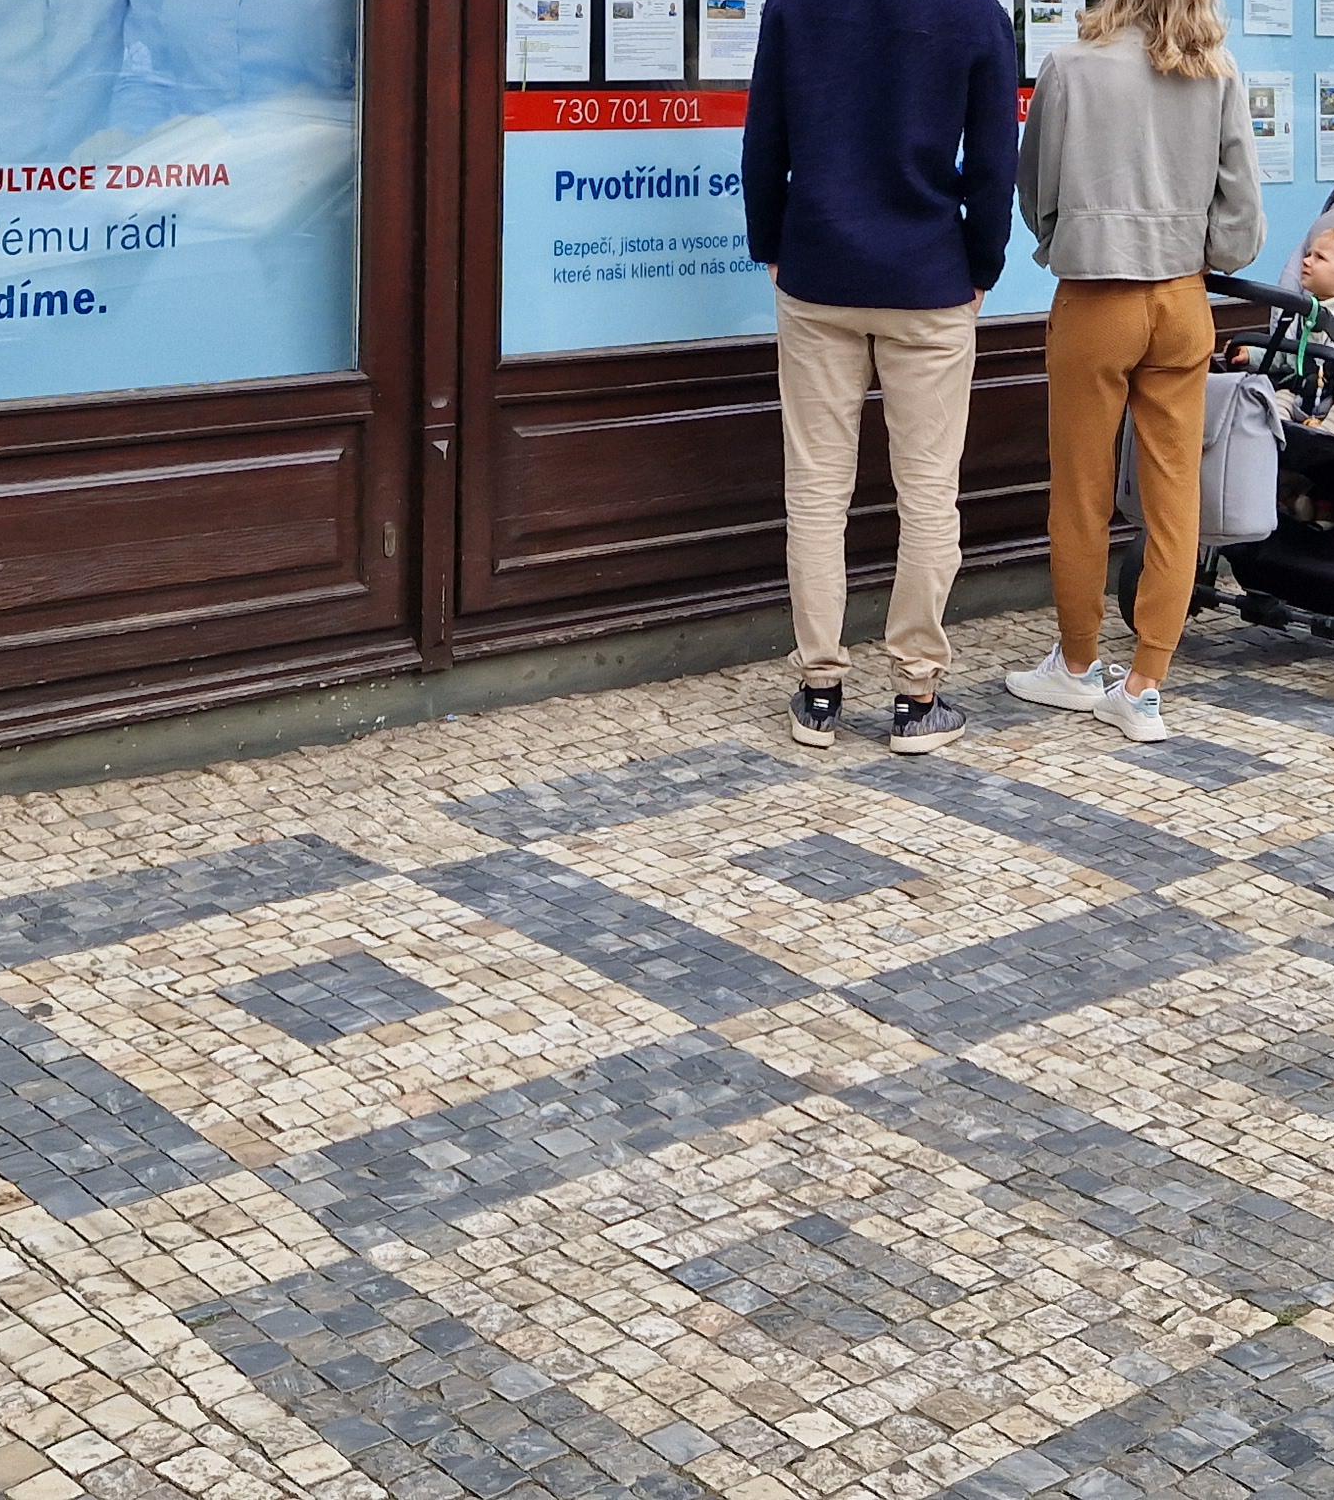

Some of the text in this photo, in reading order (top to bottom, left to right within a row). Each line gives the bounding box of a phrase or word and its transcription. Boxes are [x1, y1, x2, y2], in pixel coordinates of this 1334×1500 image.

[553, 98, 702, 124] 730 701 701
[105, 163, 230, 190] ZDARMA
[555, 165, 741, 202] Prvotřídní se
[105, 213, 178, 252] rádi
[553, 233, 750, 258] Bezpečí, jistota a vysoce pr
[553, 264, 592, 284] které
[596, 263, 627, 282] naši
[631, 262, 674, 279] klienti
[678, 260, 696, 276] od
[701, 258, 726, 275] nás
